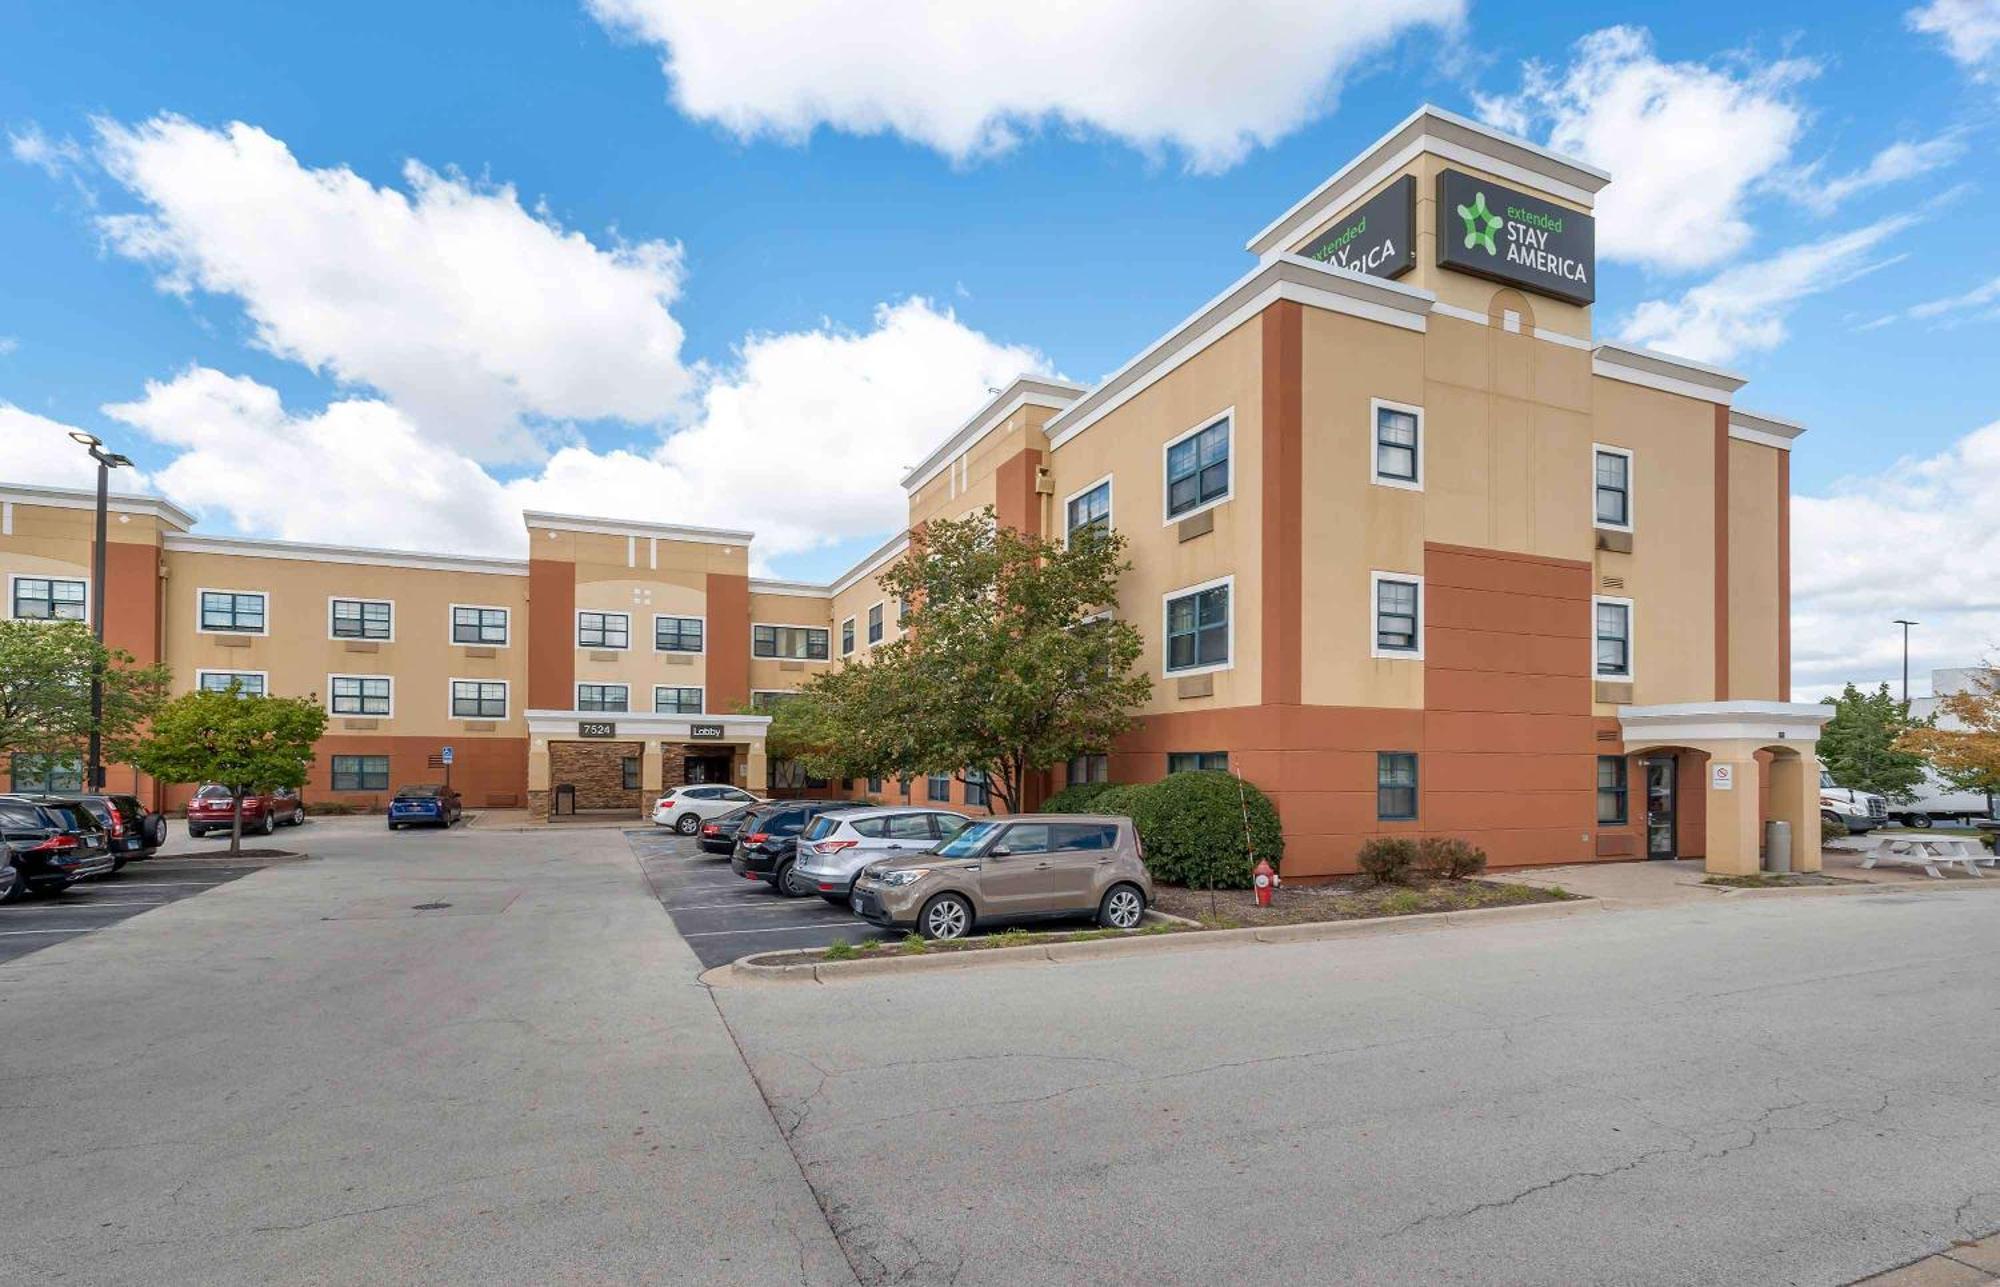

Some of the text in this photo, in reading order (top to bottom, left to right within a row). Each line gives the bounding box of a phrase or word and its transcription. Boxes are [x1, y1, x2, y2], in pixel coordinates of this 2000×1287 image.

[1507, 206, 1562, 233] extended
[1507, 221, 1548, 250] STAY
[1345, 239, 1396, 273] RICA
[1506, 243, 1587, 283] AMERICA
[583, 724, 610, 735] 7524
[693, 726, 721, 737] Lobby
